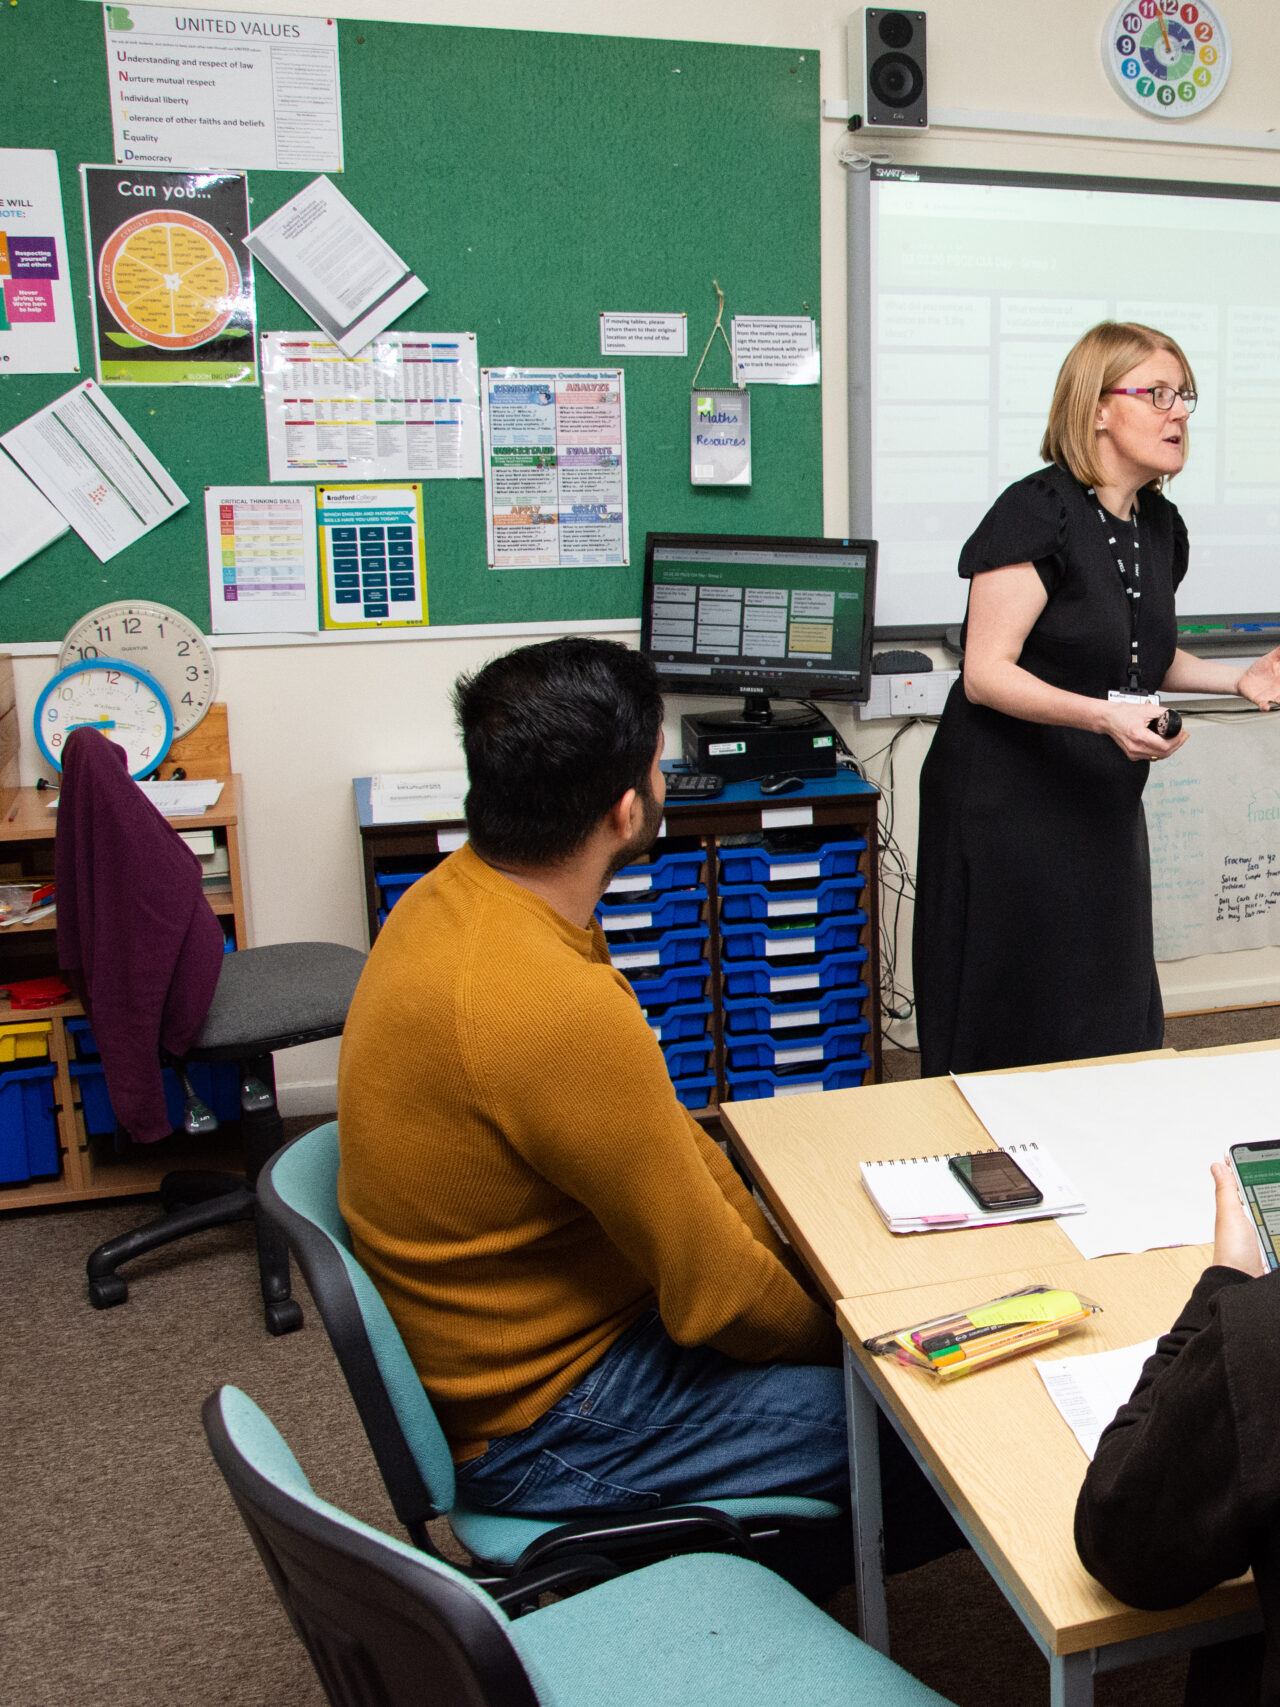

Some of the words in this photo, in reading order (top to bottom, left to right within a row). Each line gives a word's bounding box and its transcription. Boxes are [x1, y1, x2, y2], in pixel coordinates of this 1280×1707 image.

[1141, 1, 1155, 16] 11
[1161, 0, 1177, 14] 12
[175, 17, 237, 34] UNITED
[240, 22, 301, 38] VALUES
[1124, 16, 1141, 31] 10
[1199, 26, 1209, 39] 2
[1121, 38, 1132, 53] 9
[117, 51, 181, 67] Understanding
[182, 57, 197, 66] and
[199, 60, 228, 70] respect
[230, 60, 239, 69] of
[239, 61, 254, 69] law
[1204, 48, 1214, 62] 3
[1126, 62, 1137, 76] 8
[118, 71, 155, 84] Nurture
[156, 76, 185, 85] mutual
[187, 79, 216, 88] respect
[1198, 71, 1208, 84] 4
[1142, 81, 1152, 95] 7
[1183, 85, 1193, 99] 5
[120, 91, 162, 104] Individual
[163, 96, 189, 105] liberty
[1162, 89, 1172, 103] 6
[121, 110, 164, 124] Tolerance
[165, 116, 174, 124] of
[175, 117, 198, 125] other
[199, 118, 222, 126] faiths
[223, 119, 238, 127] and
[239, 119, 265, 128] beliefs
[123, 130, 158, 143] Equality
[124, 150, 173, 164] Democracy
[876, 168, 901, 178] SMART
[117, 180, 156, 197] Can
[162, 184, 211, 201] you...
[7, 199, 33, 207] WILL
[15, 250, 52, 258] Respecting
[565, 383, 610, 392] ANALYZE
[700, 411, 738, 424] Maths
[511, 505, 541, 514] APPLY
[122, 617, 142, 634] 12
[157, 623, 164, 638] 1
[96, 625, 111, 642] 11
[77, 646, 98, 660] 10
[176, 641, 190, 656] 2
[80, 672, 92, 686] 11
[106, 671, 121, 685] 12
[185, 665, 199, 681] 3
[56, 687, 73, 701] 10
[181, 691, 194, 706] 4
[146, 700, 158, 713] 2
[47, 708, 58, 722] 9
[151, 724, 162, 738] 3
[51, 733, 62, 747] 8
[140, 746, 150, 759] 4
